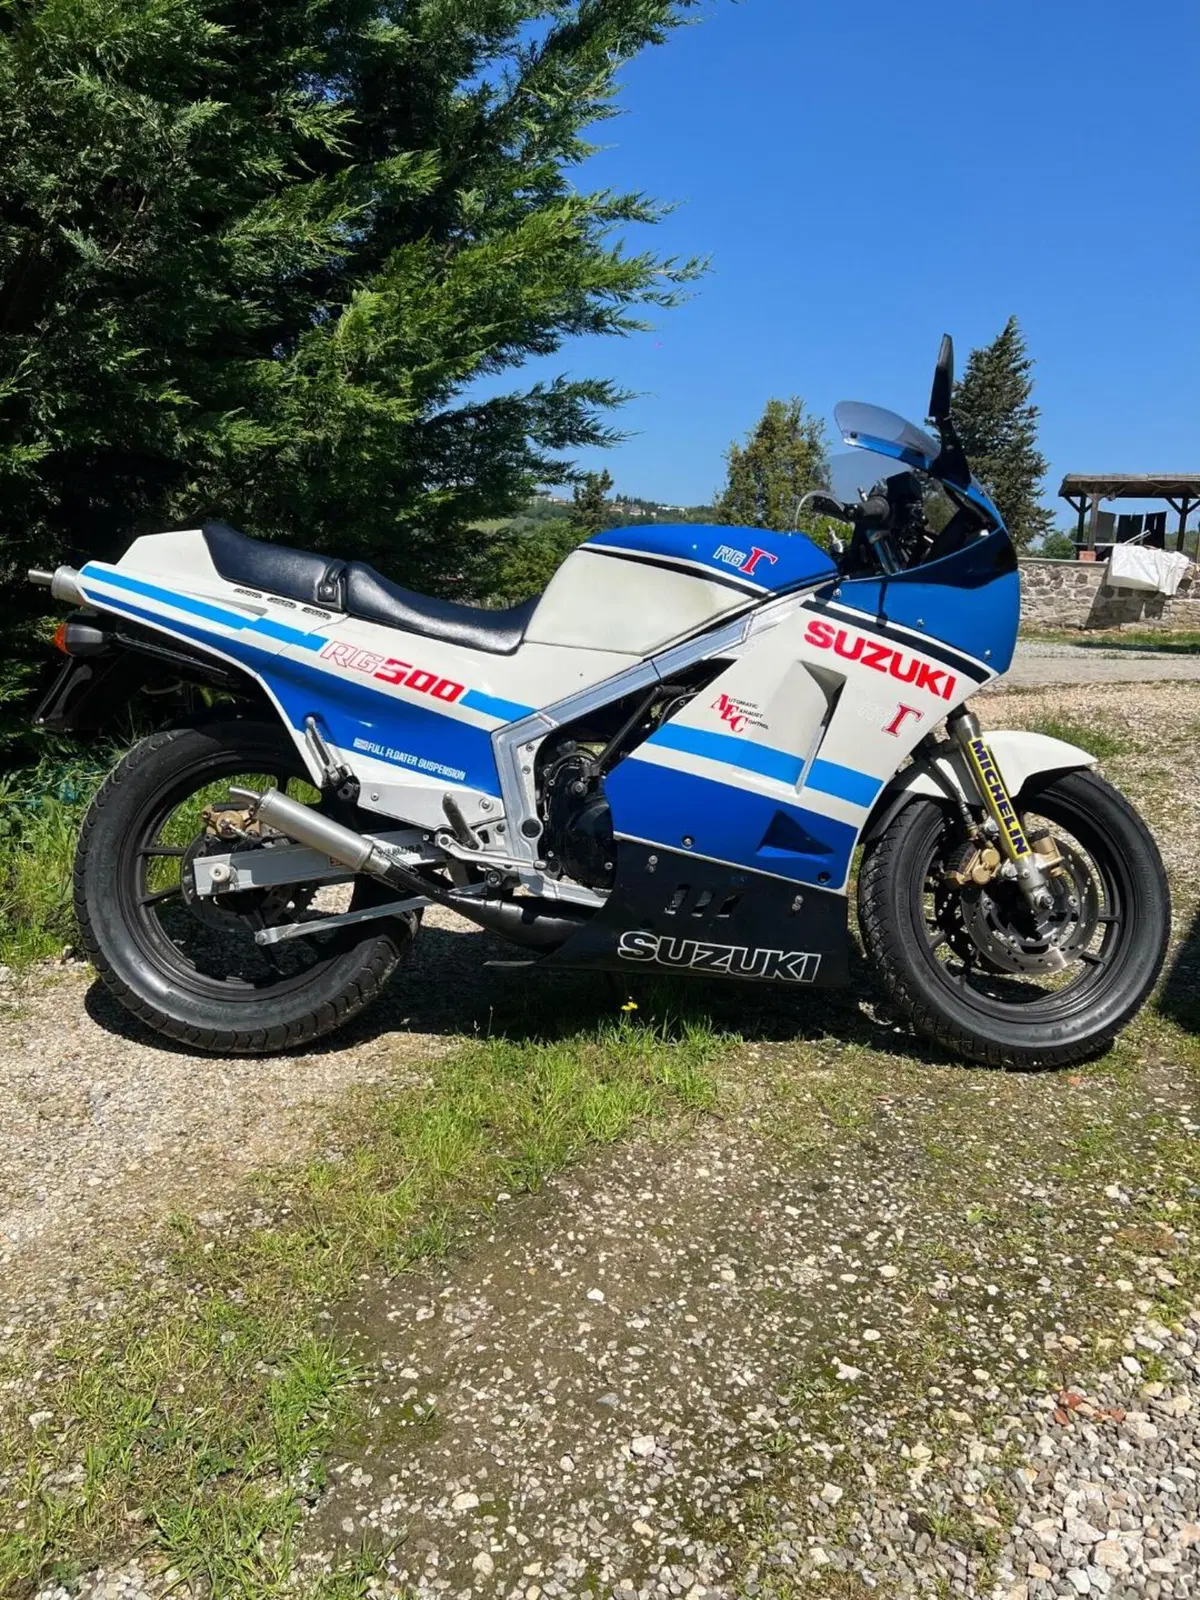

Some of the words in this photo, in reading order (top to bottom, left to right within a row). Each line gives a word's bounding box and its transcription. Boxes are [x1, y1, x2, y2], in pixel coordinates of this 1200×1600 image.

[319, 640, 466, 703] RG500
[803, 620, 957, 701] SUZUKI
[366, 742, 385, 757] FULL
[384, 747, 419, 767] FLOATER
[417, 757, 467, 781] SUSPENSION
[971, 739, 1028, 854] MICHELIN
[617, 930, 822, 983] SUZUKI
